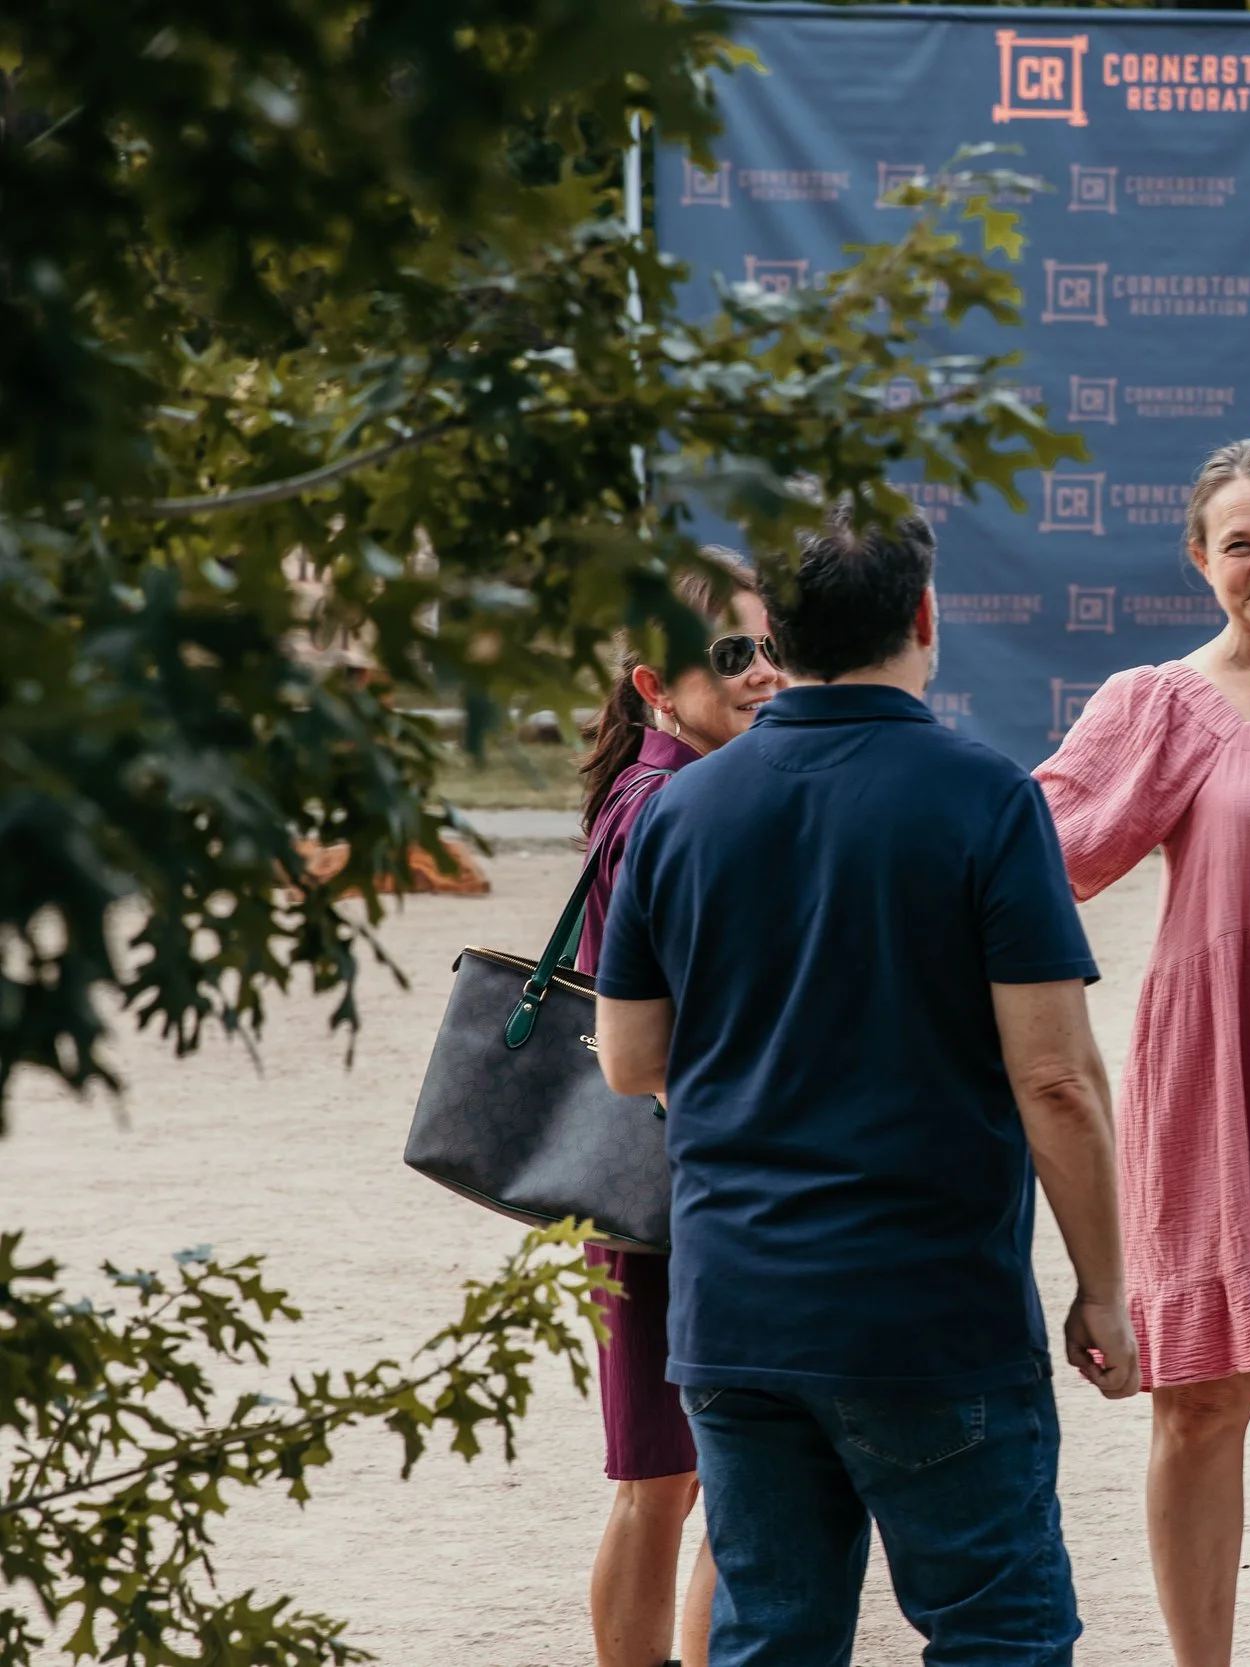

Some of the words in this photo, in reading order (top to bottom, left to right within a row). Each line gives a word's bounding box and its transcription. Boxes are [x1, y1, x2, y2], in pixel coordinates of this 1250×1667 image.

[1016, 57, 1064, 100] CR
[1081, 177, 1106, 200] CR
[1125, 176, 1236, 195] CORNERSTONE
[1058, 277, 1091, 308] CR
[1129, 298, 1249, 316] RESTORATION
[1080, 389, 1105, 411] CR
[1124, 386, 1235, 405] CORNERSTONE
[1056, 487, 1089, 518] CR
